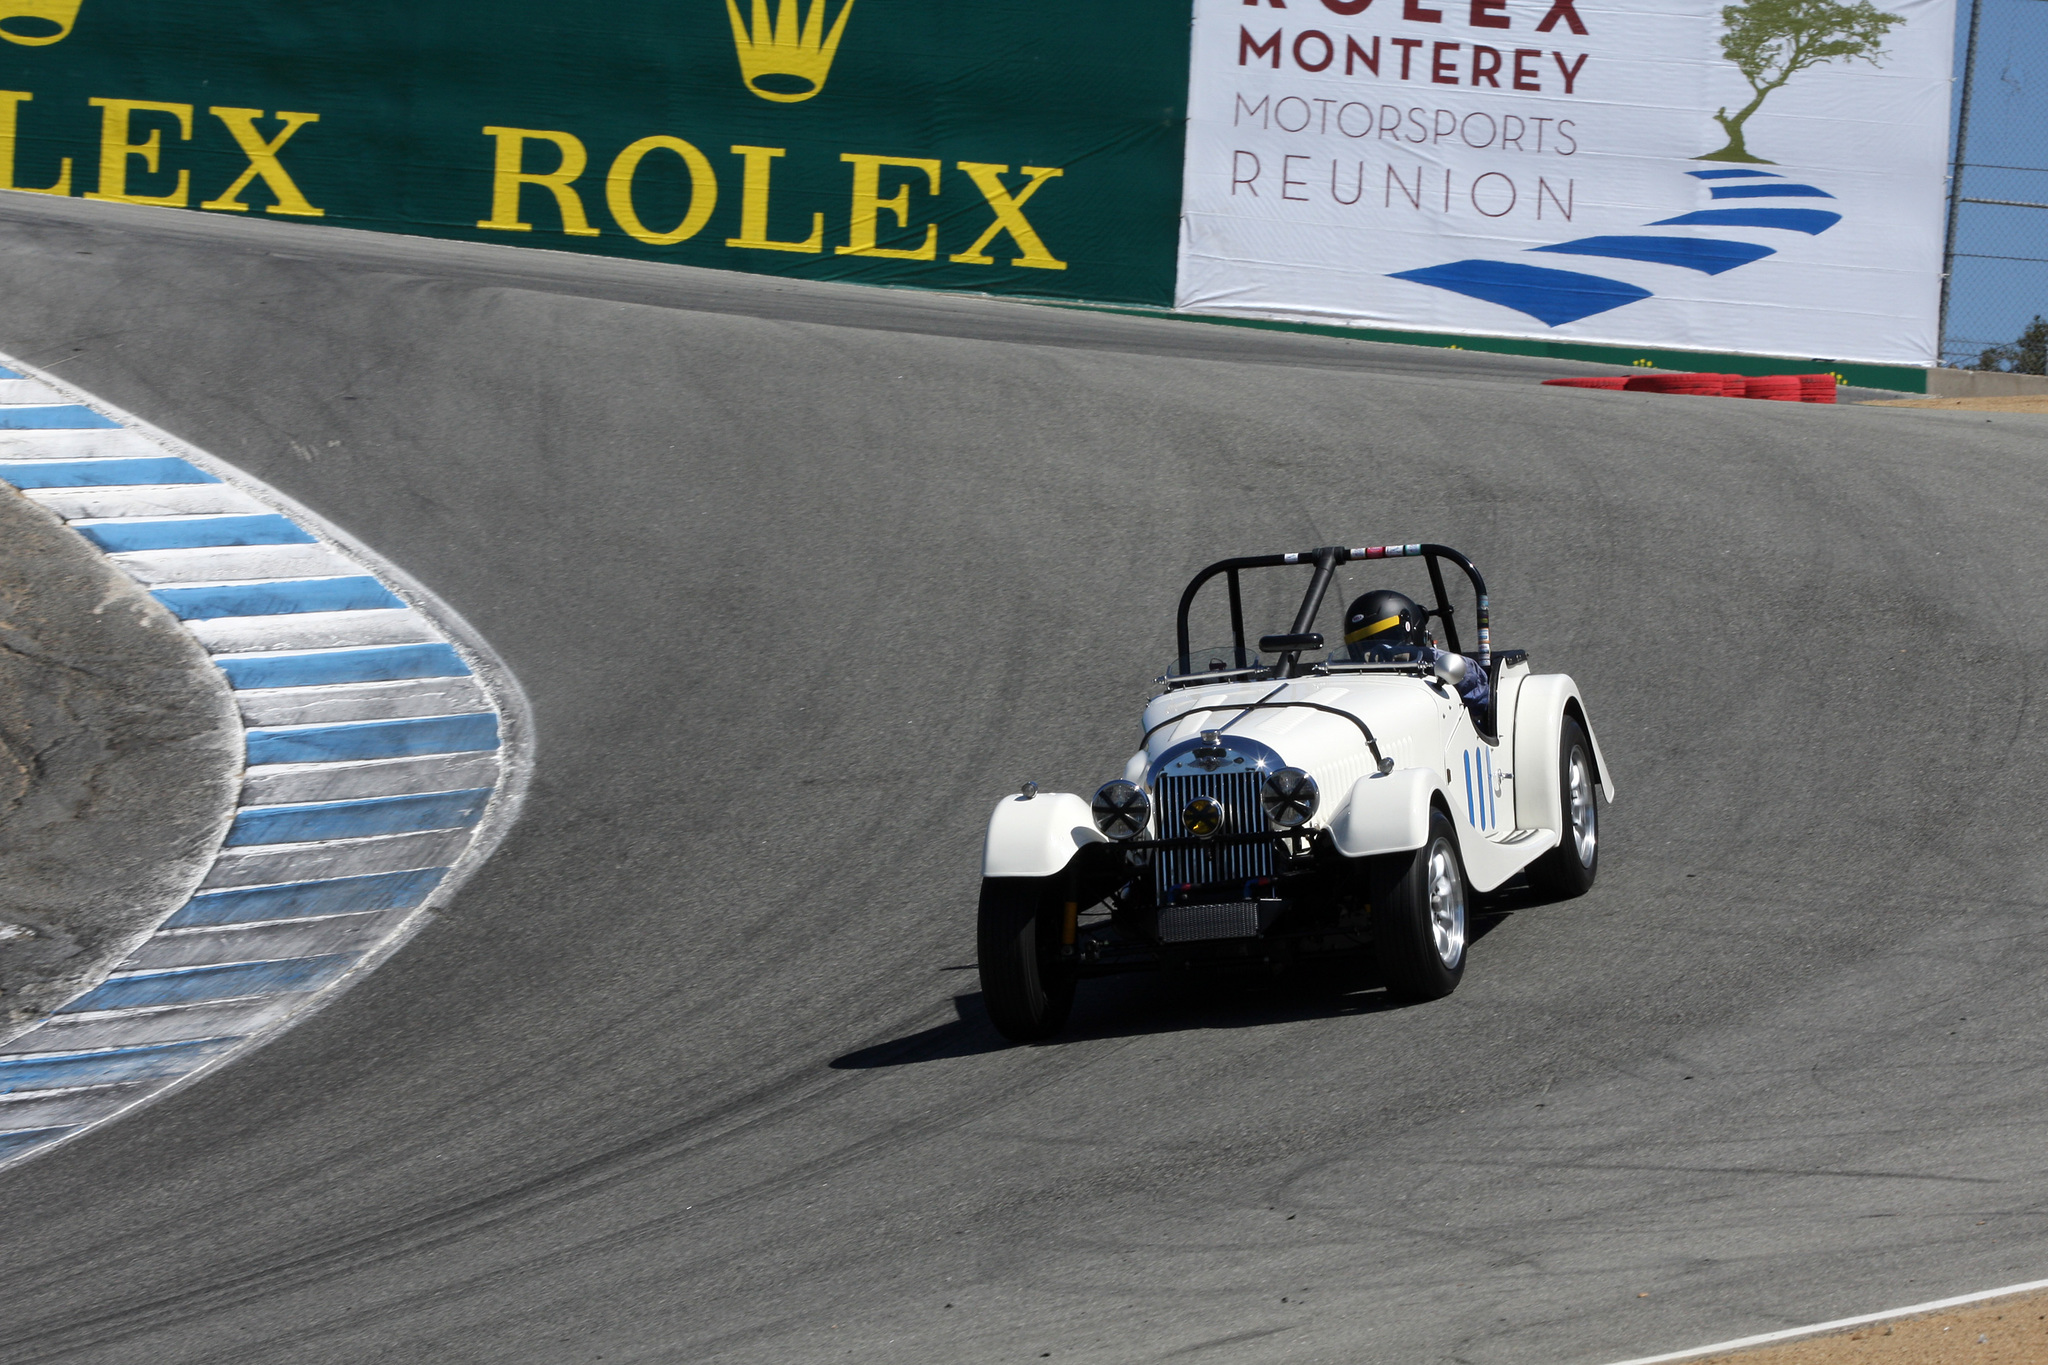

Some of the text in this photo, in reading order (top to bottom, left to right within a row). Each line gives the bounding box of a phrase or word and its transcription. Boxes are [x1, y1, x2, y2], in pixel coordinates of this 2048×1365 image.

[1242, 0, 1589, 36] LEX
[1239, 26, 1588, 95] MONTEREY
[1234, 92, 1577, 156] MOTORSPORTS
[477, 126, 1066, 270] ROLEX
[1232, 150, 1574, 222] REUNION
